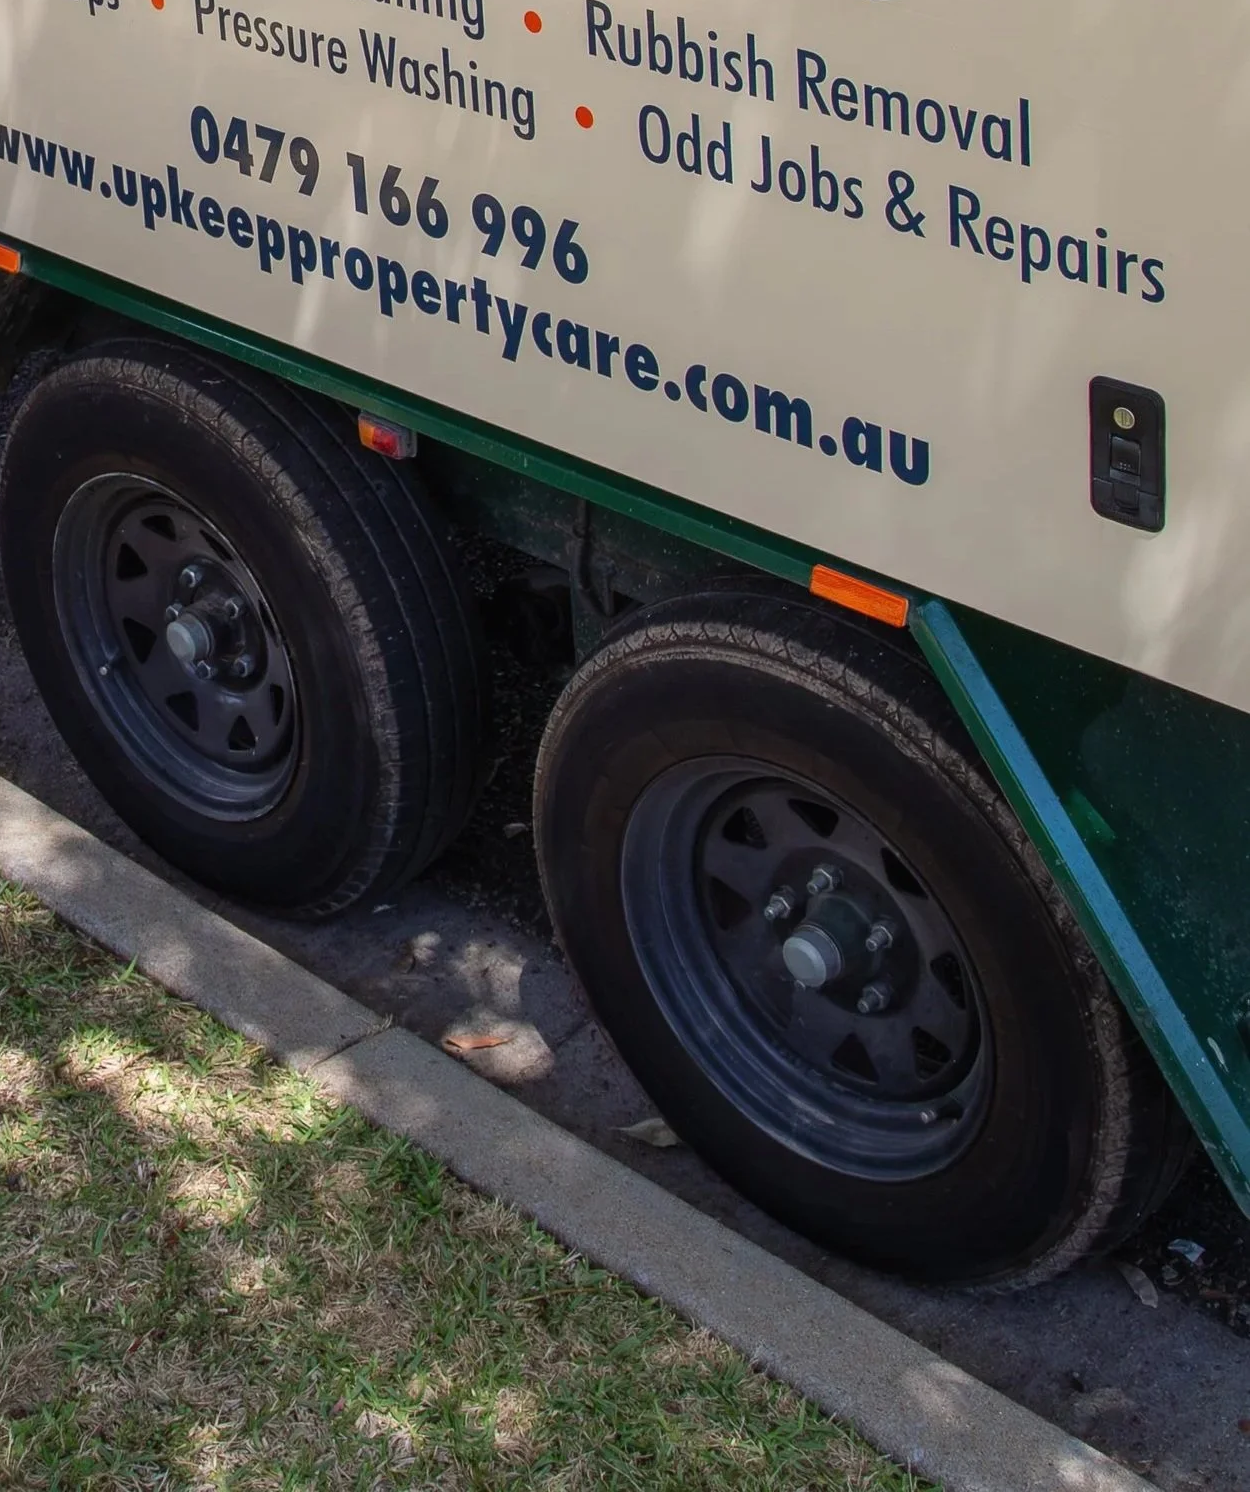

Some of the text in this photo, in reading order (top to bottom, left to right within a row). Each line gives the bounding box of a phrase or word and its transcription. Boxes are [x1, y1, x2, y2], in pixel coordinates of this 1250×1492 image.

[190, 105, 589, 285] 0479 166 996
[358, 27, 537, 141] Washing
[638, 104, 734, 185] Odd
[750, 134, 864, 220] Jobs
[884, 169, 927, 239] &
[948, 184, 1165, 304] Repairs
[796, 48, 1031, 168] Removal
